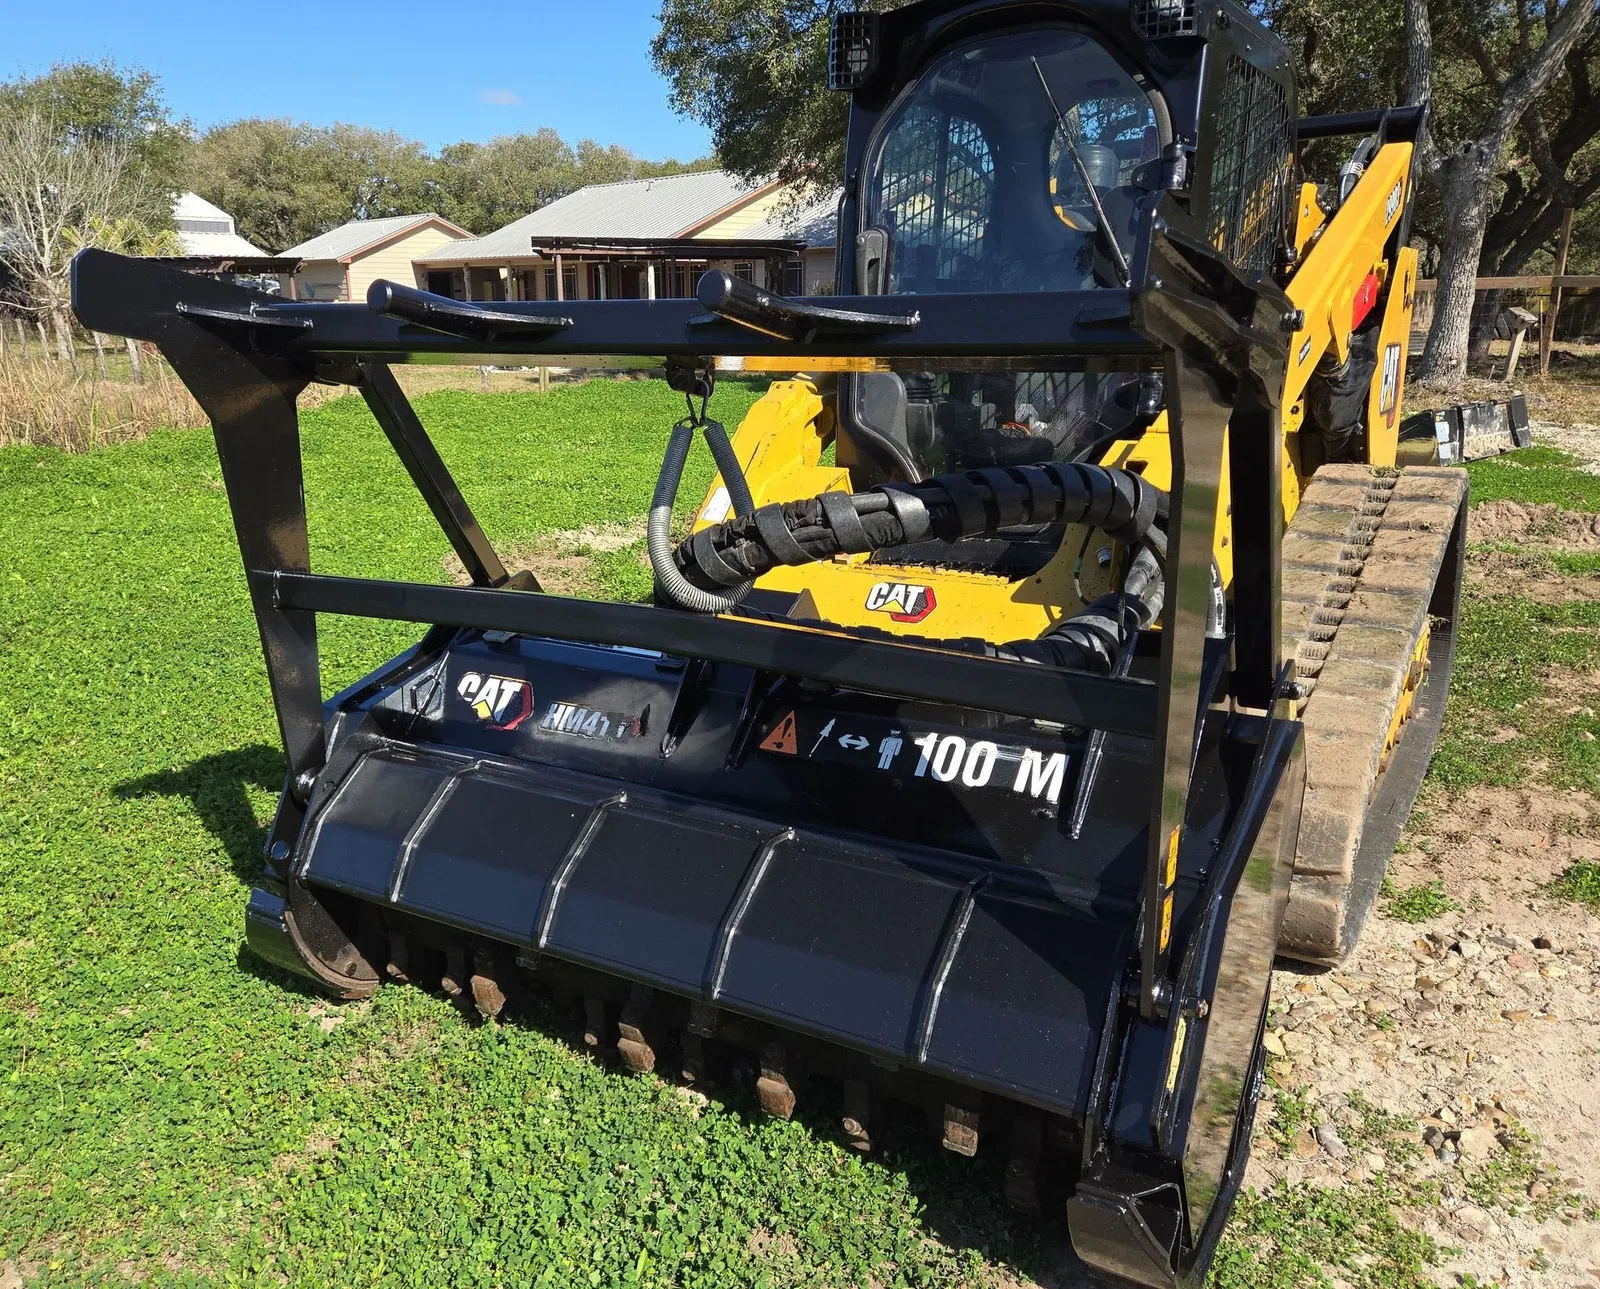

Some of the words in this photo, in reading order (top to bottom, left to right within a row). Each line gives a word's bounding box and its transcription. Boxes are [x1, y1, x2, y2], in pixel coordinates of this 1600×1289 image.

[1380, 345, 1400, 413] CAT
[866, 582, 926, 615] CAT
[457, 673, 523, 722] CAT
[914, 732, 998, 788] 100
[1012, 747, 1070, 804] M
